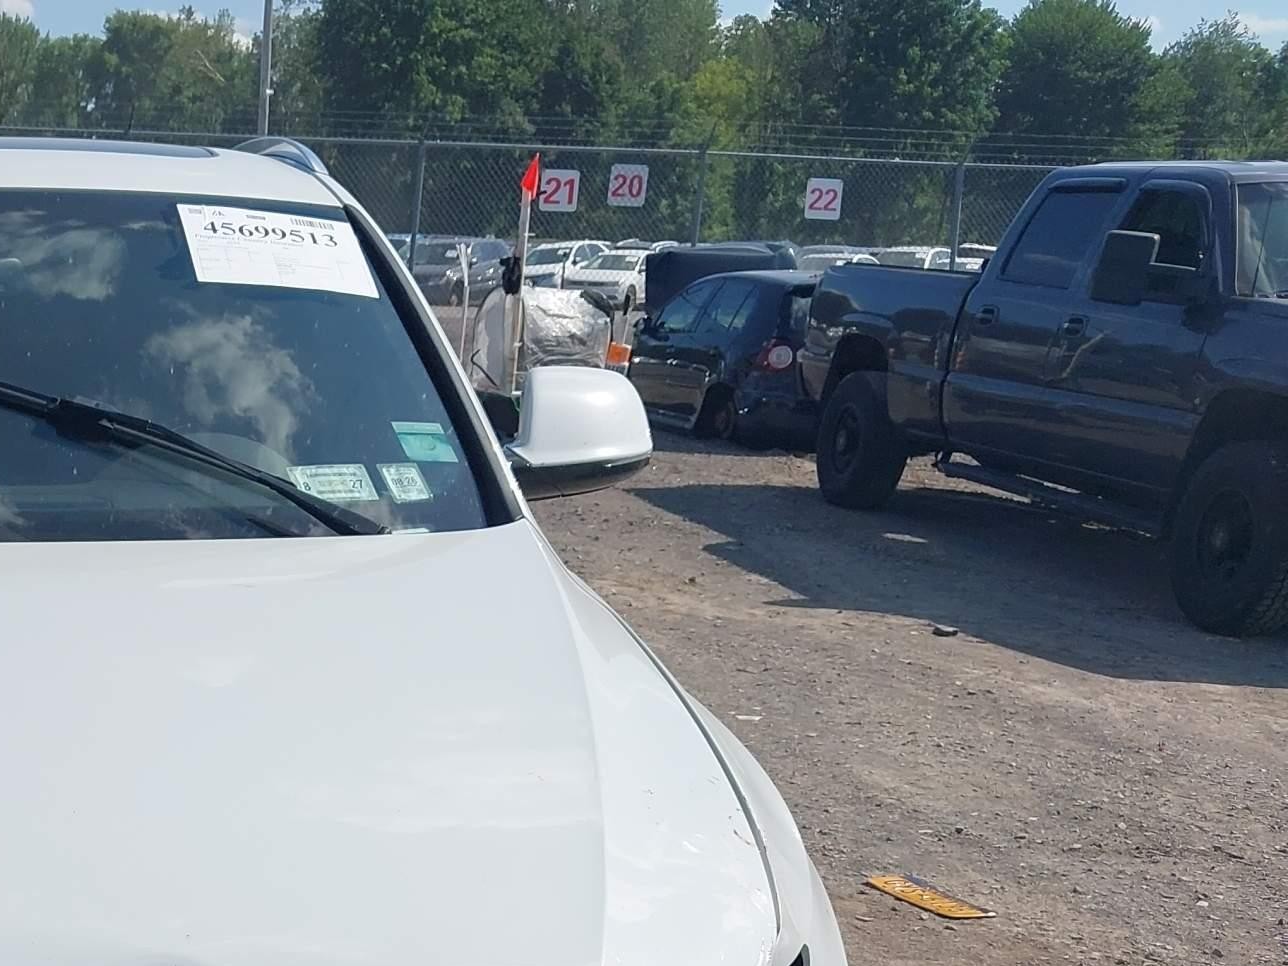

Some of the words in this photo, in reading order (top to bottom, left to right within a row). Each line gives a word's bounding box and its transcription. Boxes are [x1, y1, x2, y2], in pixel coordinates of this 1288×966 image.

[542, 177, 576, 205] 21
[610, 173, 643, 198] 20
[808, 187, 838, 212] 22
[203, 220, 339, 248] 45699513
[349, 478, 364, 489] 27
